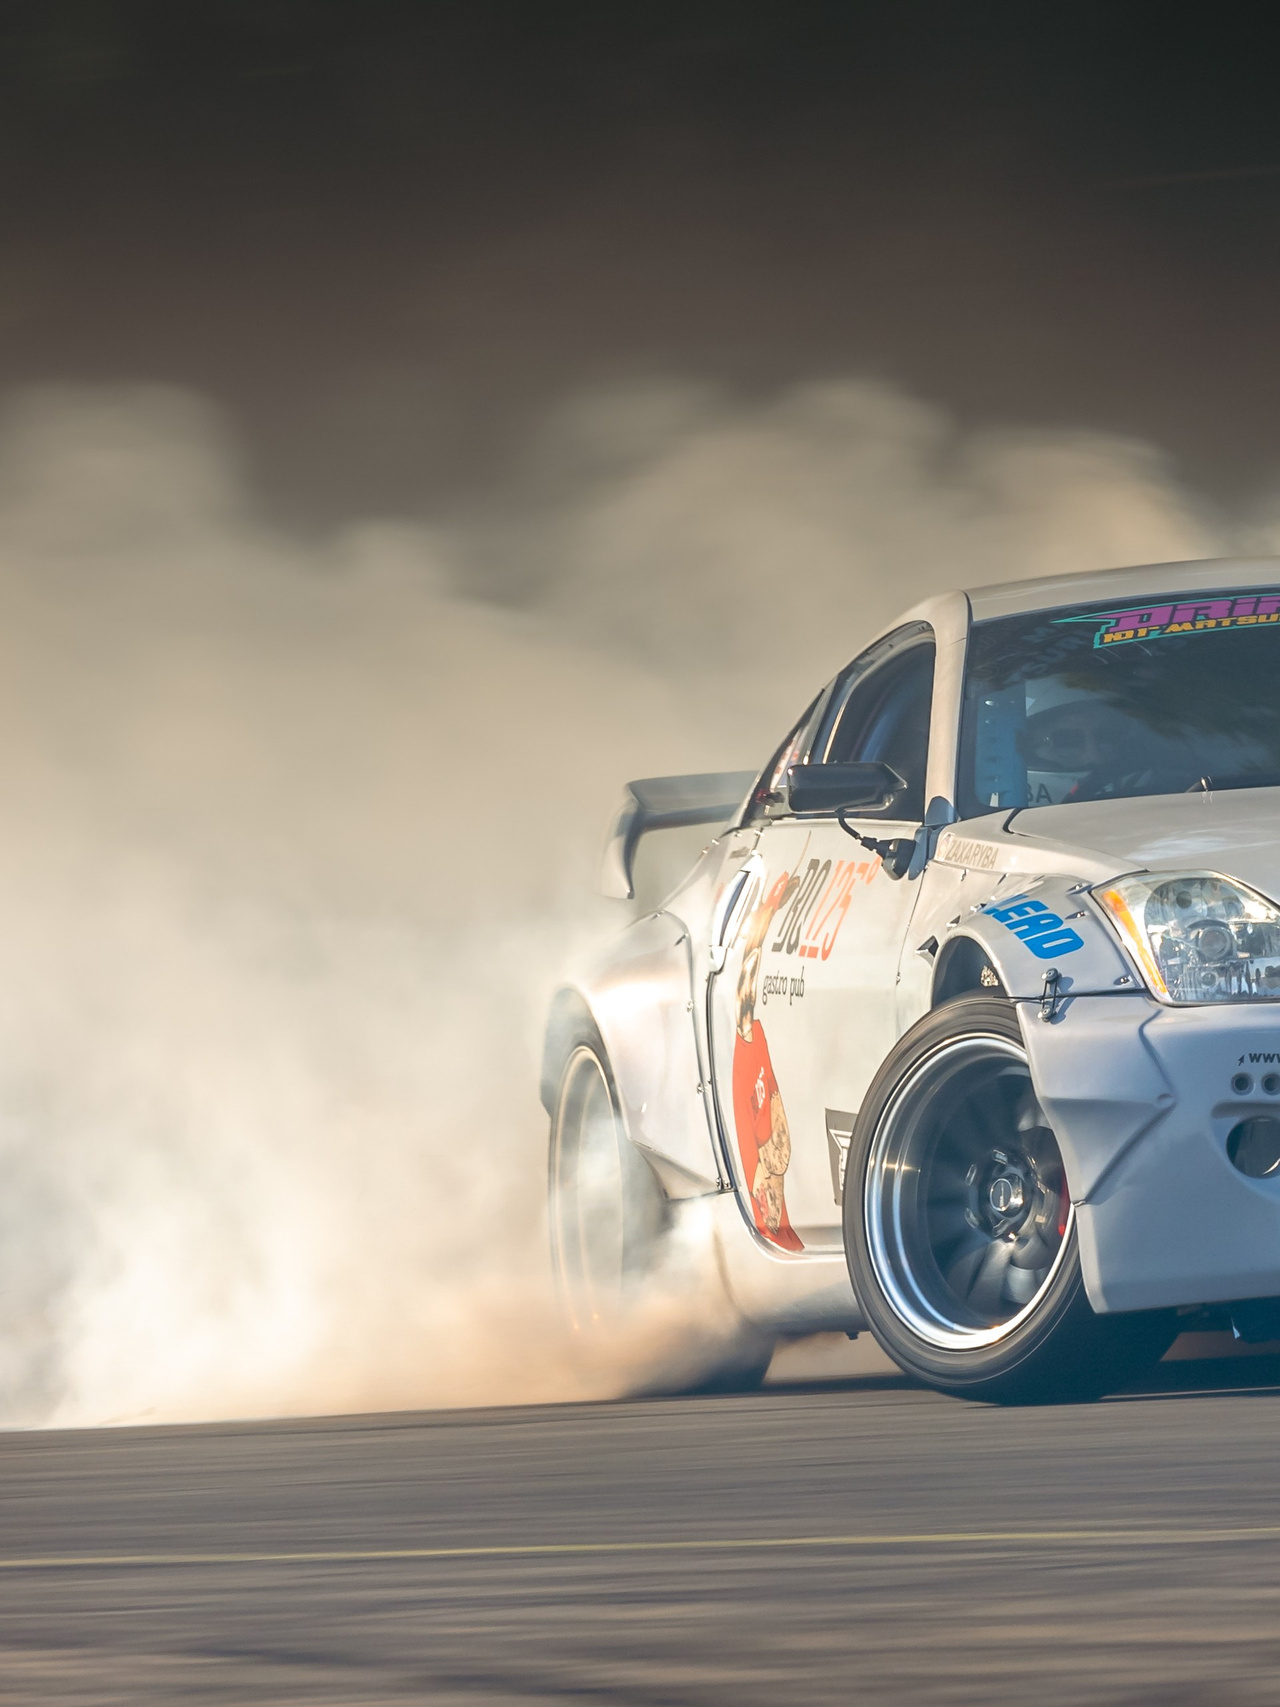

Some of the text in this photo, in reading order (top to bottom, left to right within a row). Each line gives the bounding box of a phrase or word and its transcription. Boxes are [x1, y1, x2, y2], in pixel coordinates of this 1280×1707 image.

[945, 839, 999, 869] ZAXARYBA
[762, 966, 805, 1006] gastro pub
